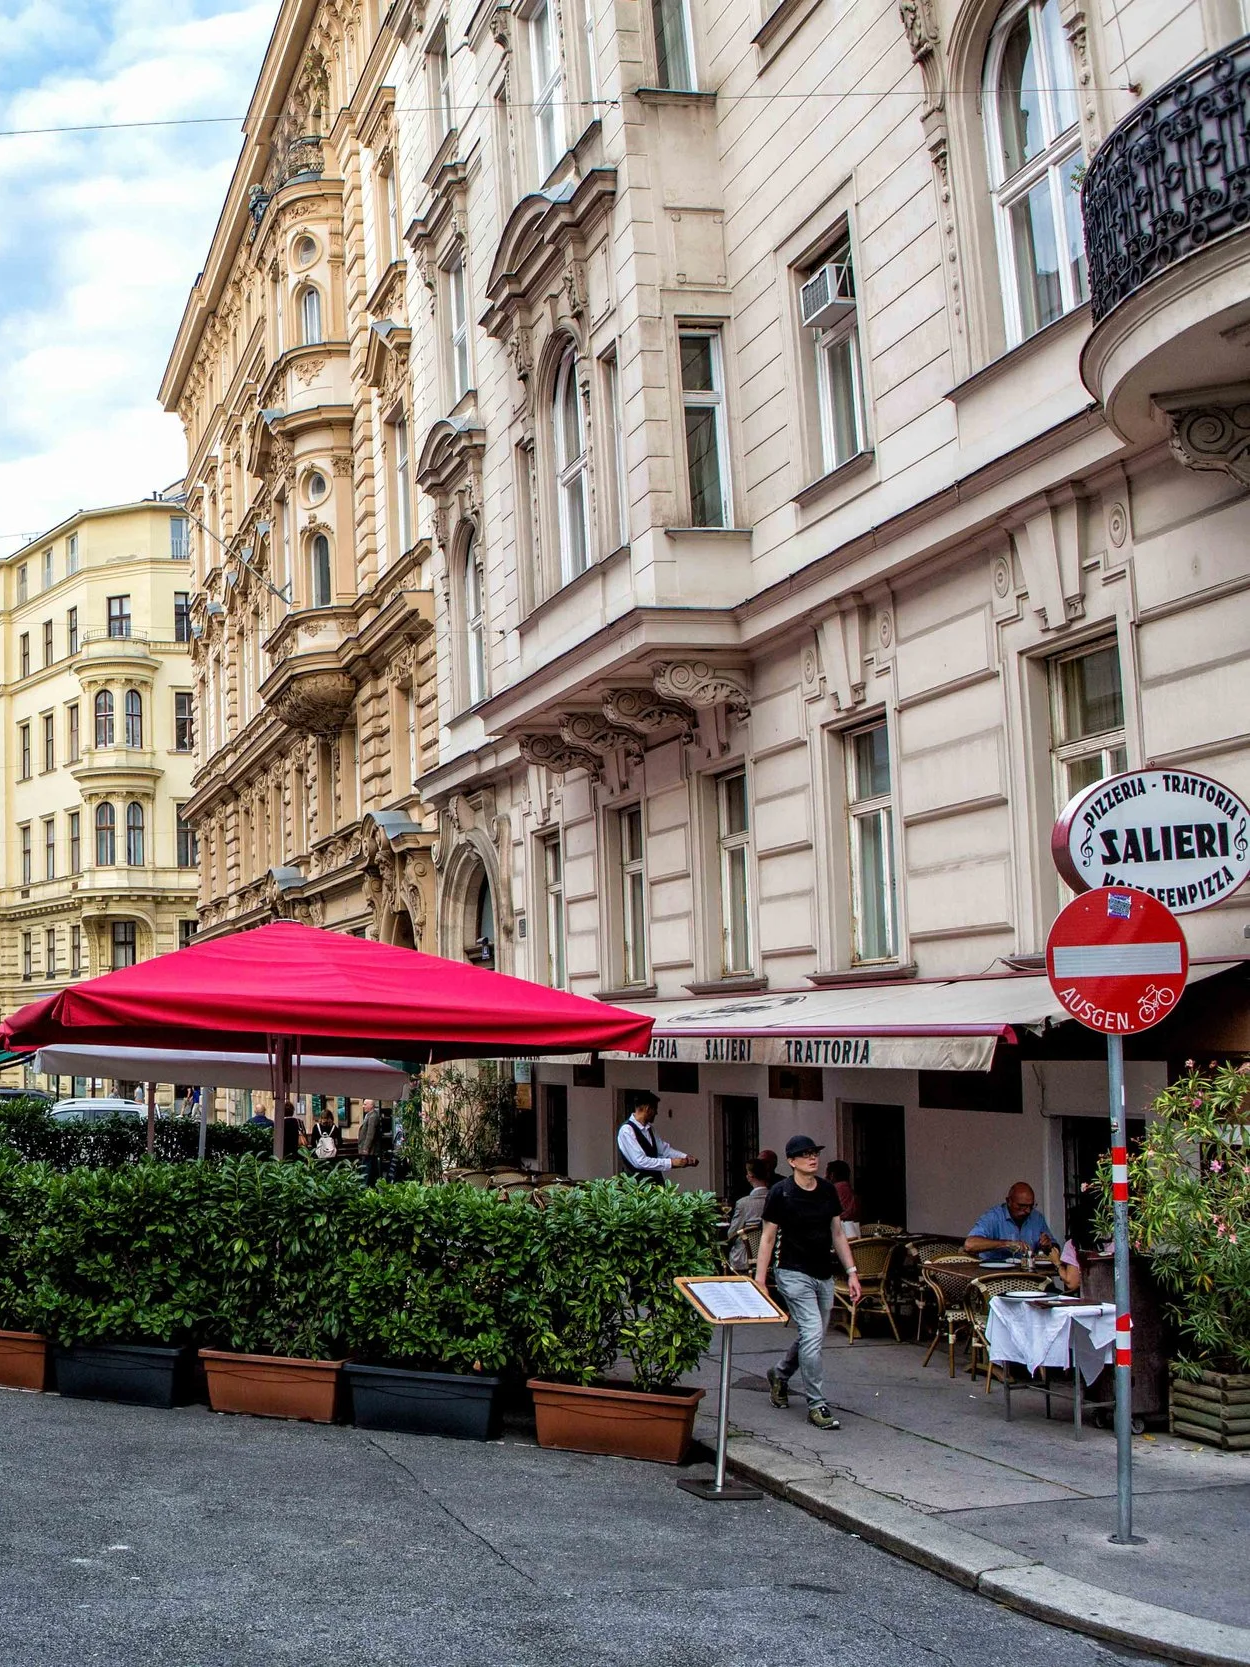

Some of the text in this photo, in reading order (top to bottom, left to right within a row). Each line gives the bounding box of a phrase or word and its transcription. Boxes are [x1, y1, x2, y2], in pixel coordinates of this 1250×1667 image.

[1083, 777, 1147, 830] PIZZERIA
[1162, 774, 1239, 821] TRATTORIA
[1099, 822, 1229, 865] SALIERI
[1059, 987, 1135, 1030] AUSGEN.
[705, 1039, 751, 1061] SALIERI
[785, 1040, 870, 1064] TRATTORIA
